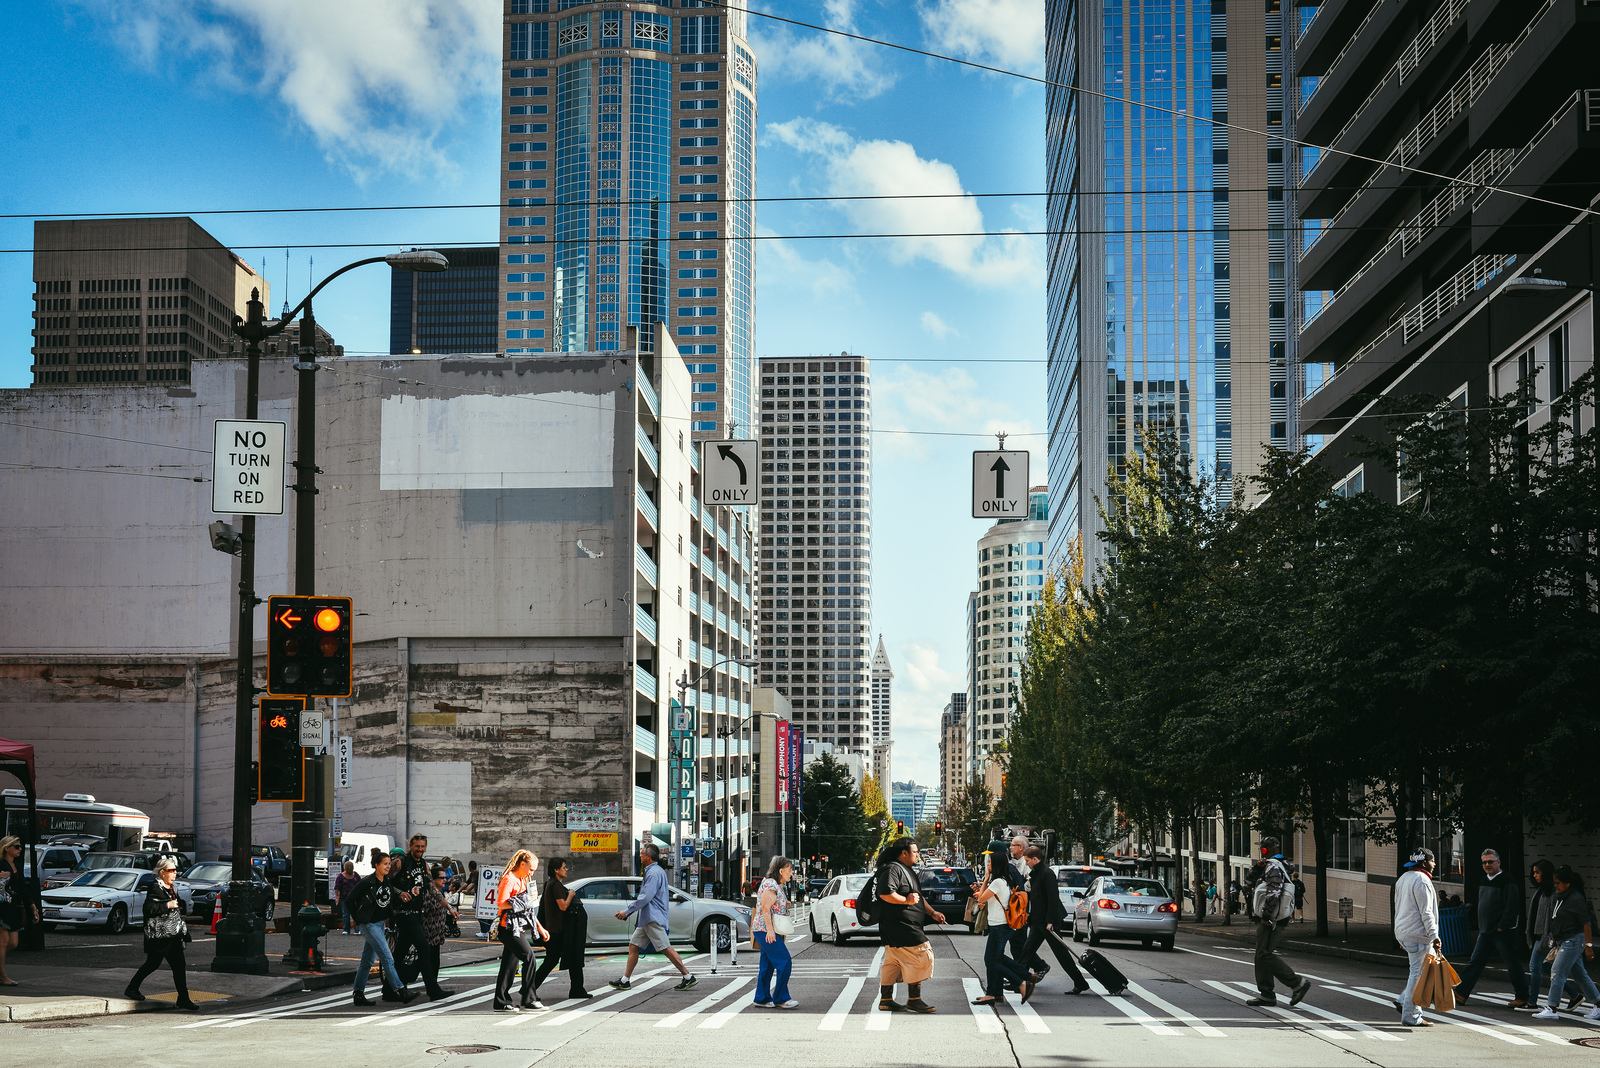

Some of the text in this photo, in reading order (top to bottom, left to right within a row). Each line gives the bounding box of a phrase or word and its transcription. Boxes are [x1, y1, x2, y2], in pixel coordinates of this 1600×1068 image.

[234, 430, 267, 449] NO
[229, 453, 270, 467] TURN
[238, 472, 259, 485] ON
[233, 490, 264, 504] RED
[712, 489, 749, 501] ONLY
[982, 500, 1018, 512] ONLY
[340, 757, 348, 779] HERE
